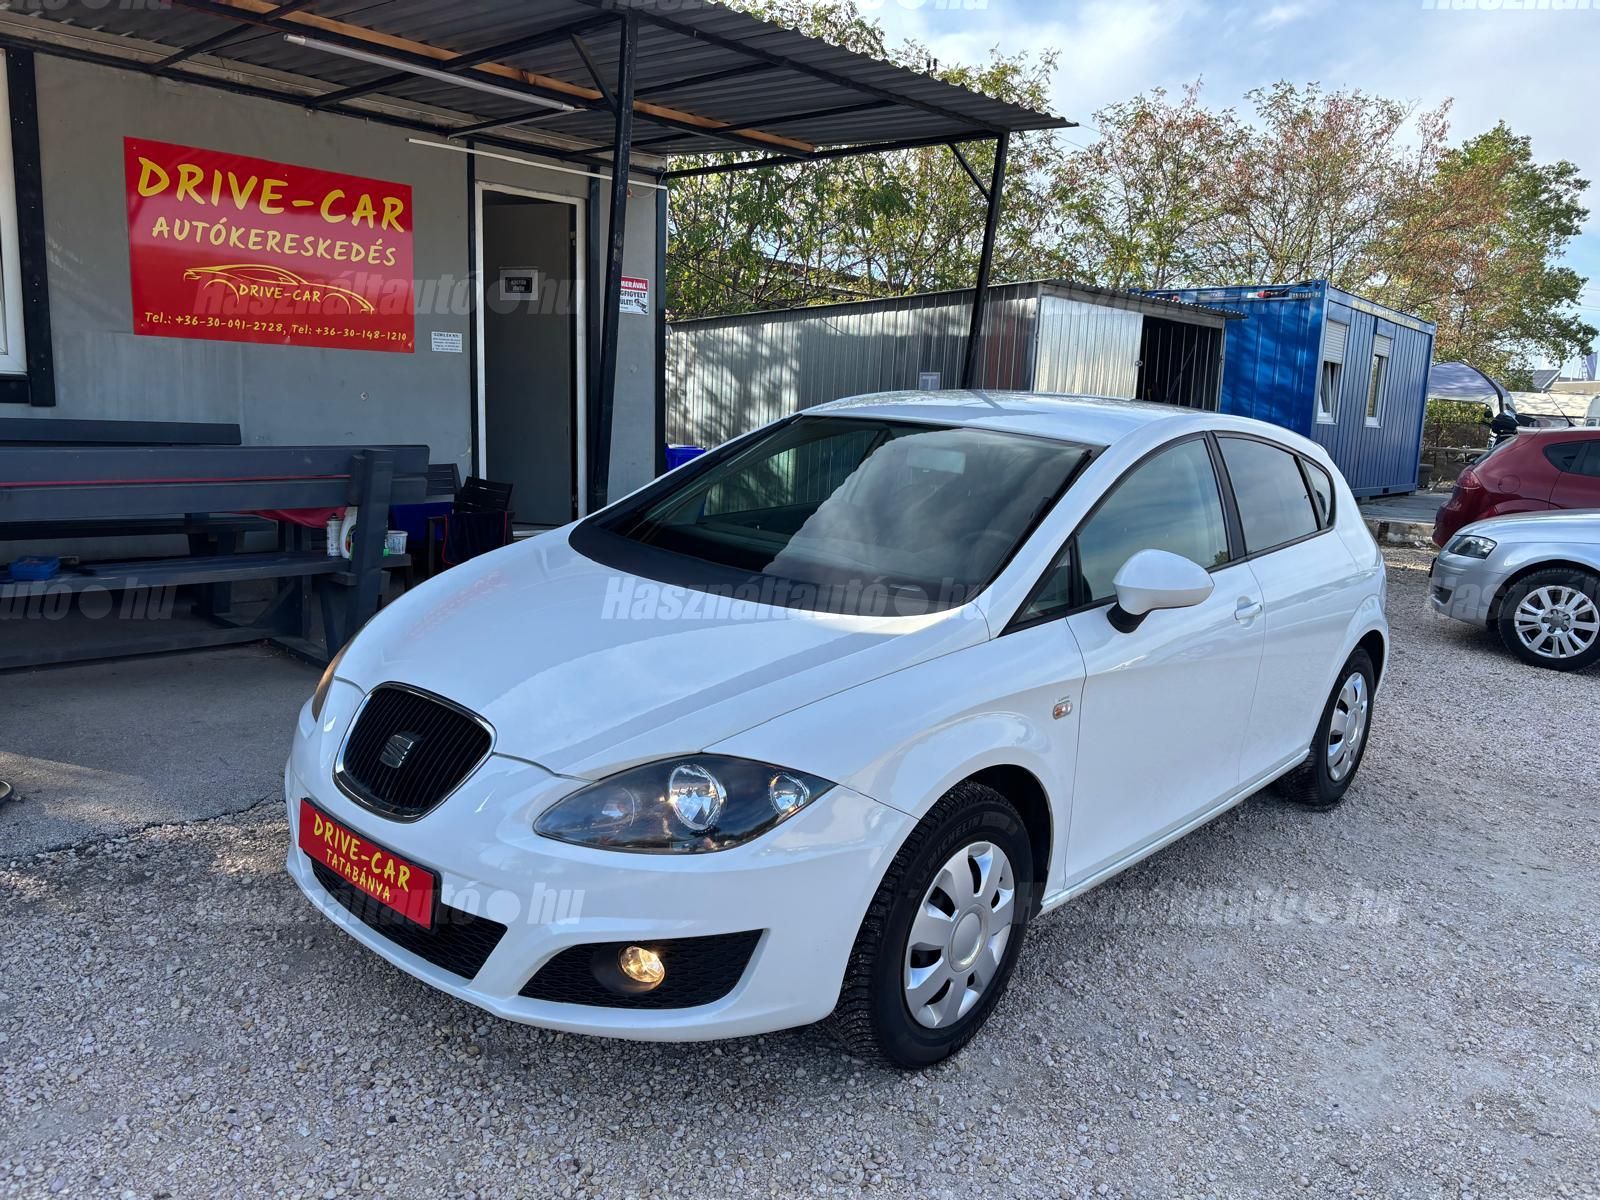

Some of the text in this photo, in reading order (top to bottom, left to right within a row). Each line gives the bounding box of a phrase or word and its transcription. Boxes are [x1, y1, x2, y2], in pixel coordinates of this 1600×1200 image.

[137, 156, 405, 232] DRIVE-CAR
[152, 216, 397, 267] AUTÓKERESKEDÉS
[238, 283, 321, 303] DRIVE-CAR
[312, 813, 411, 893] DRIVE-CAR
[325, 848, 391, 902] TATABÁNYA
